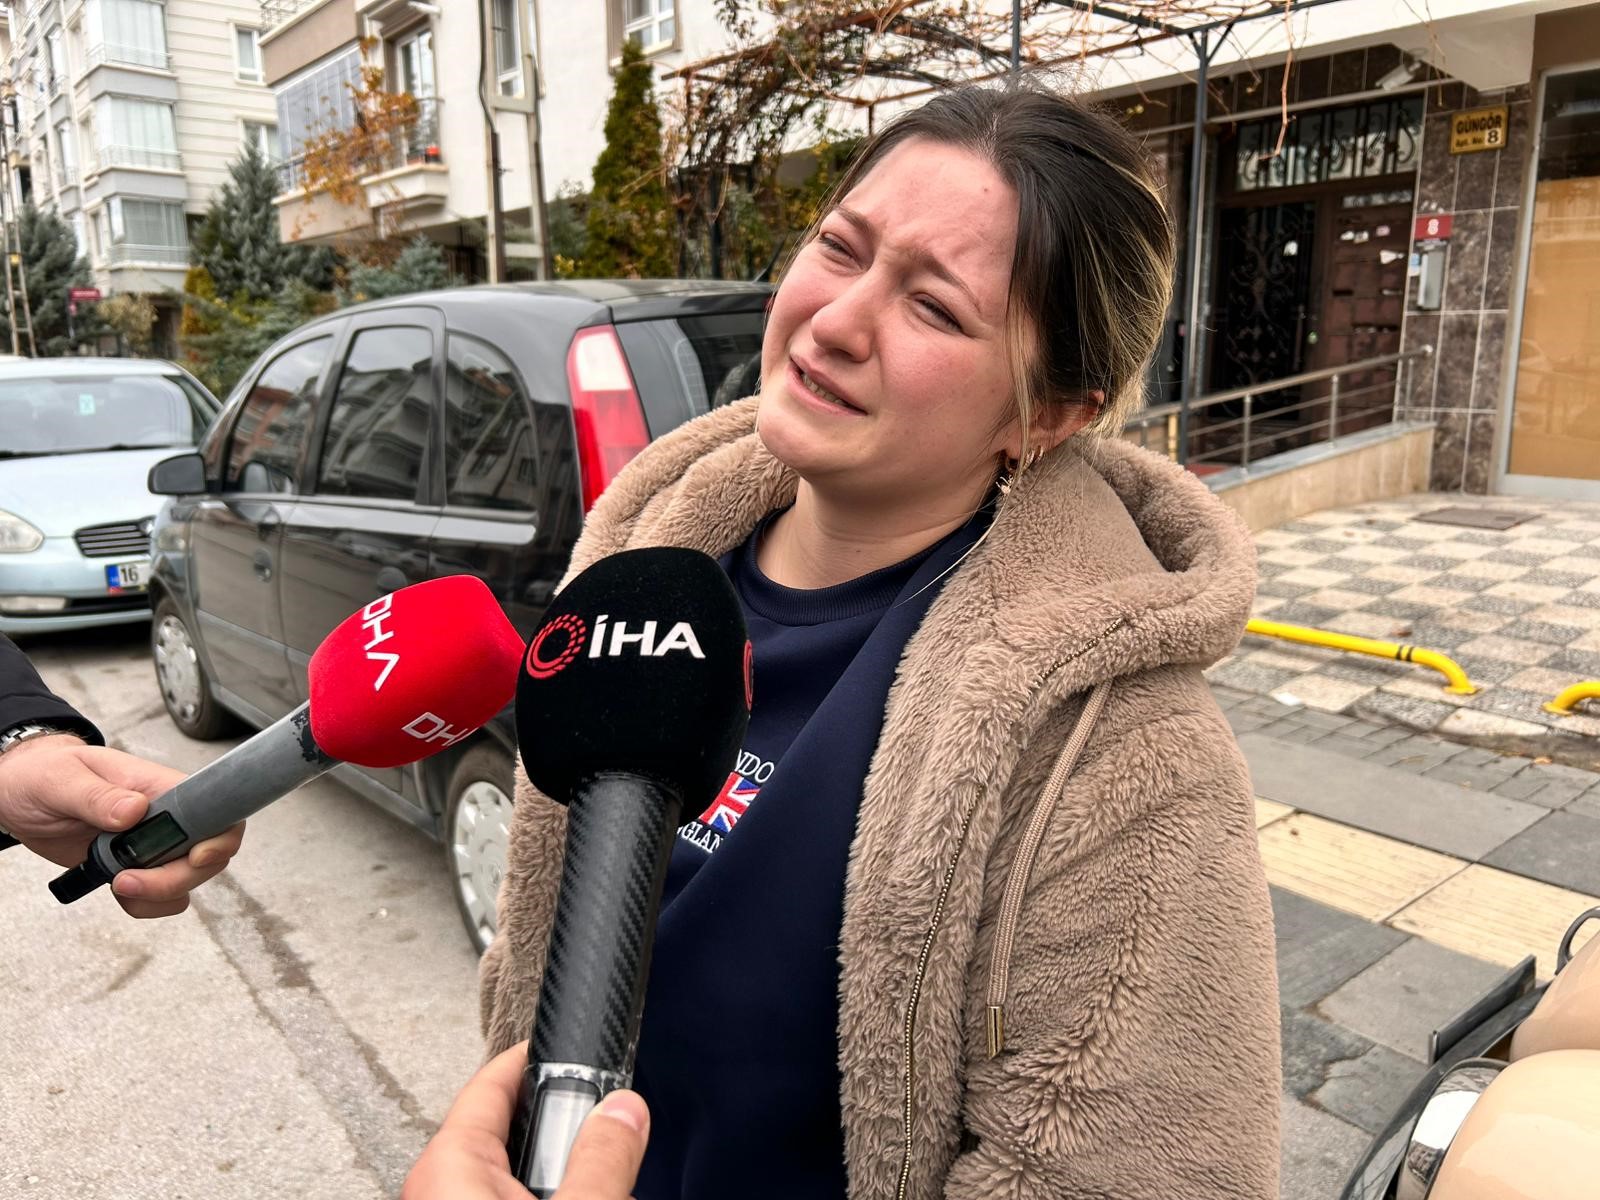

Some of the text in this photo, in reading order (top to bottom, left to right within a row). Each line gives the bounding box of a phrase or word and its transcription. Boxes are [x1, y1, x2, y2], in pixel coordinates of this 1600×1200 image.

[1456, 113, 1502, 135] GÜNGÖR
[1487, 129, 1499, 144] 8
[1427, 218, 1440, 235] 8
[121, 567, 139, 583] 16
[588, 614, 706, 659] İHA
